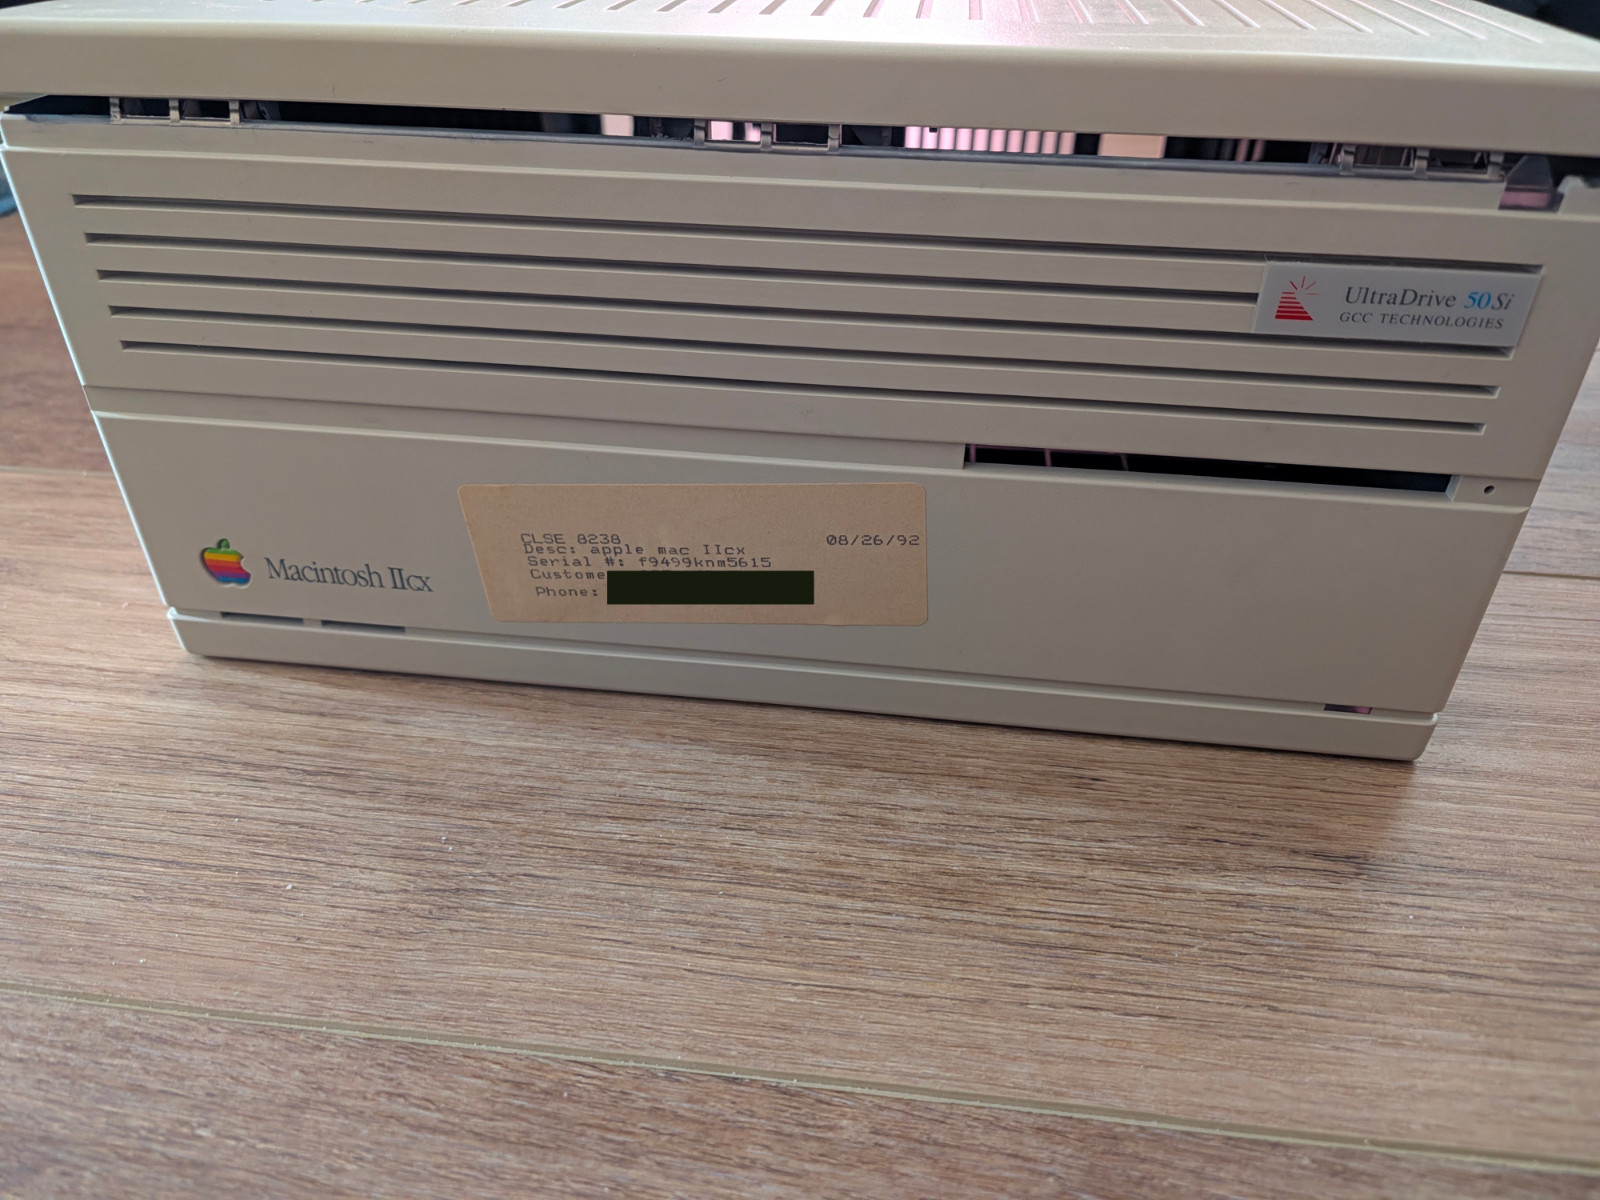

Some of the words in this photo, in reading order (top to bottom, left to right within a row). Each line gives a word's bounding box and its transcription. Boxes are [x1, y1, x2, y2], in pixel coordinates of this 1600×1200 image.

[1345, 285, 1456, 308] UltraDrive
[1339, 312, 1373, 324] GCC
[1380, 313, 1504, 330] TECHNOLOGIES
[520, 533, 566, 544] CLSE
[577, 533, 621, 545] 8238
[826, 534, 920, 546] 08/26/92
[523, 543, 576, 554] Desc:
[590, 544, 644, 557] apple
[657, 546, 690, 555] mac
[703, 544, 745, 555] IIcx
[527, 555, 592, 567] Serial
[604, 556, 624, 567] #:
[264, 557, 385, 588] Macintosh
[388, 567, 434, 592] IIcx
[530, 568, 606, 580] Custome
[535, 586, 599, 597] Phone:
